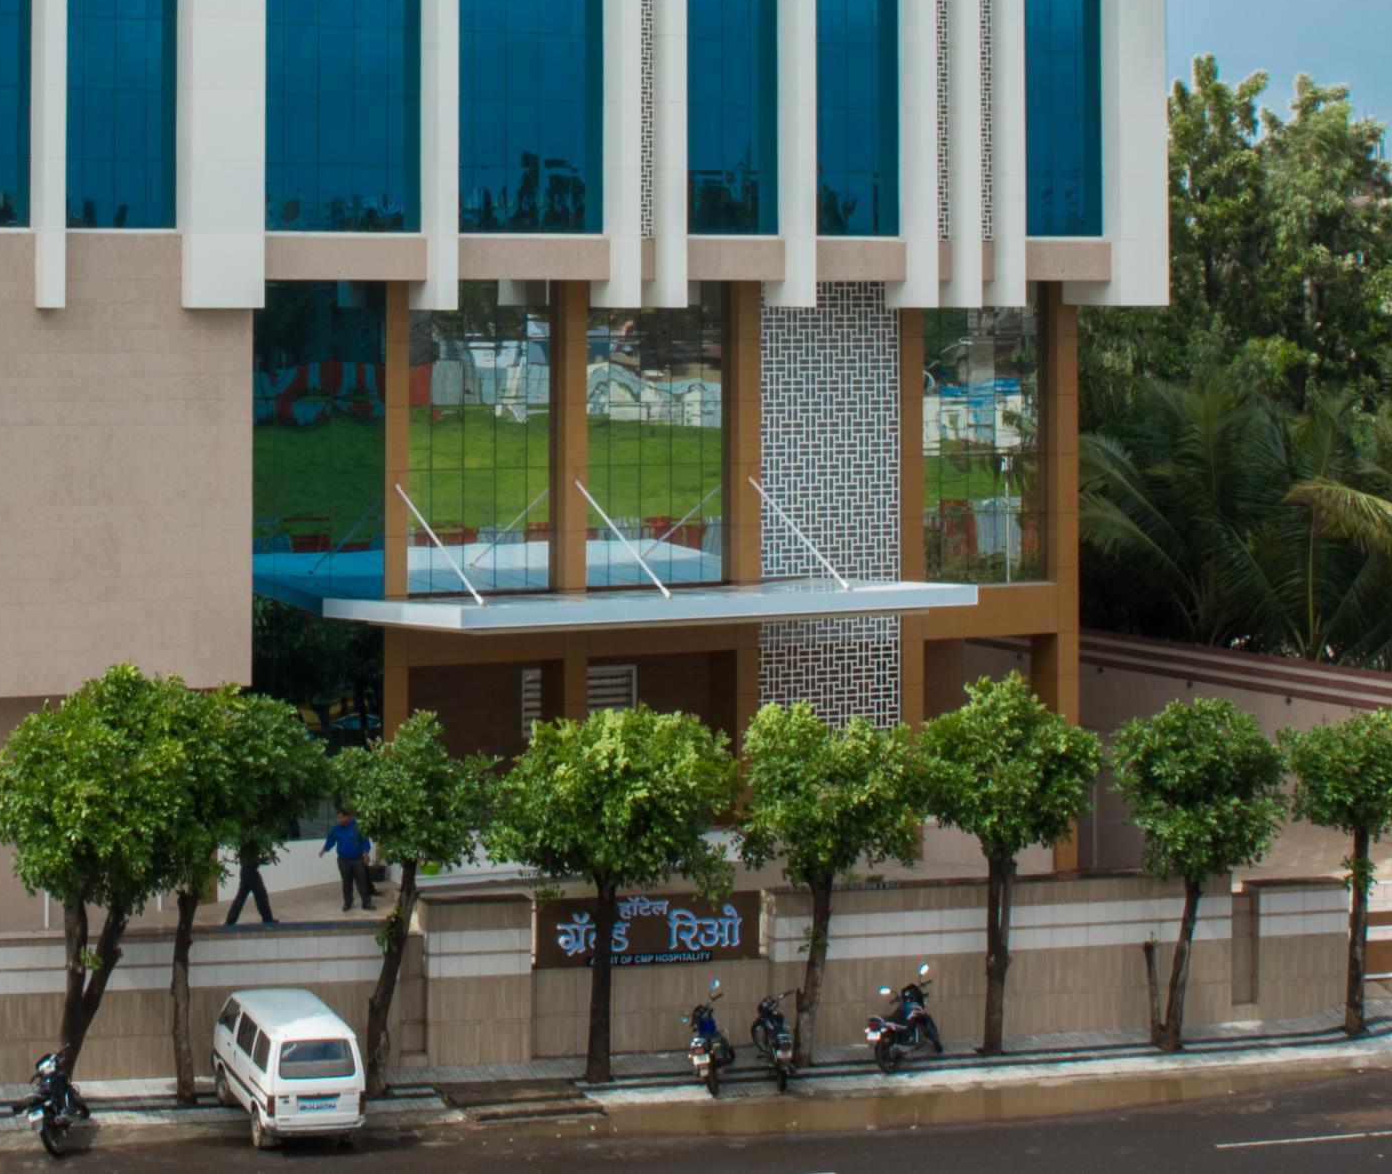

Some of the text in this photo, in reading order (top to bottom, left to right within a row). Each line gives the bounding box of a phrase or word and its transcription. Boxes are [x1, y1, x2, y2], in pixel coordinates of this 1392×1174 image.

[618, 896, 669, 919] हॉटेल
[668, 903, 742, 950] रिओ
[620, 954, 633, 963] OF
[634, 953, 654, 963] CMP
[655, 951, 711, 963] HOSPITALITY
